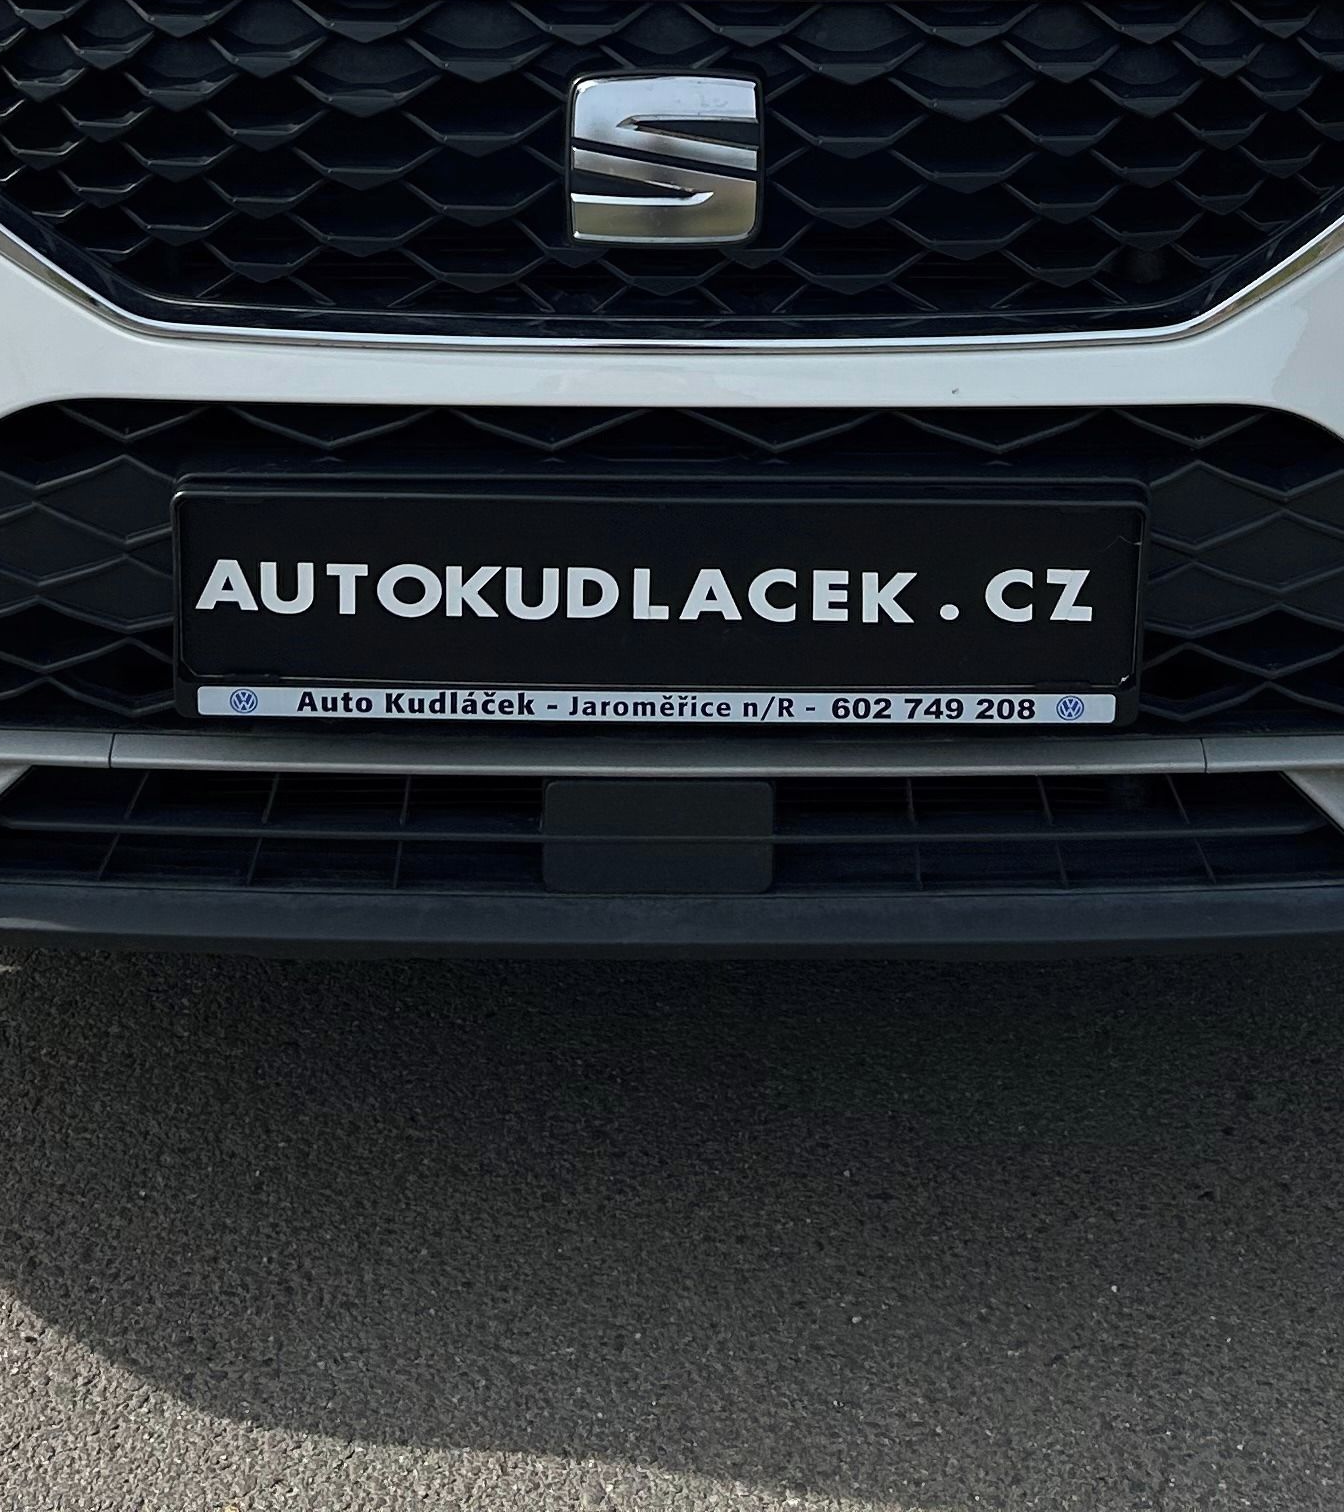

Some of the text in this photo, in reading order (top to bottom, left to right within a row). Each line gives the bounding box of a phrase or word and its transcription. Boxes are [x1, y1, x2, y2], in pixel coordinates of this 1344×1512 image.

[296, 691, 373, 713] Auto
[385, 691, 536, 716] Kudláček
[568, 694, 732, 718] Jaroměřice
[743, 695, 795, 721] n/R
[831, 697, 892, 720] 602
[904, 698, 964, 720] 749
[975, 698, 1036, 720] 208
